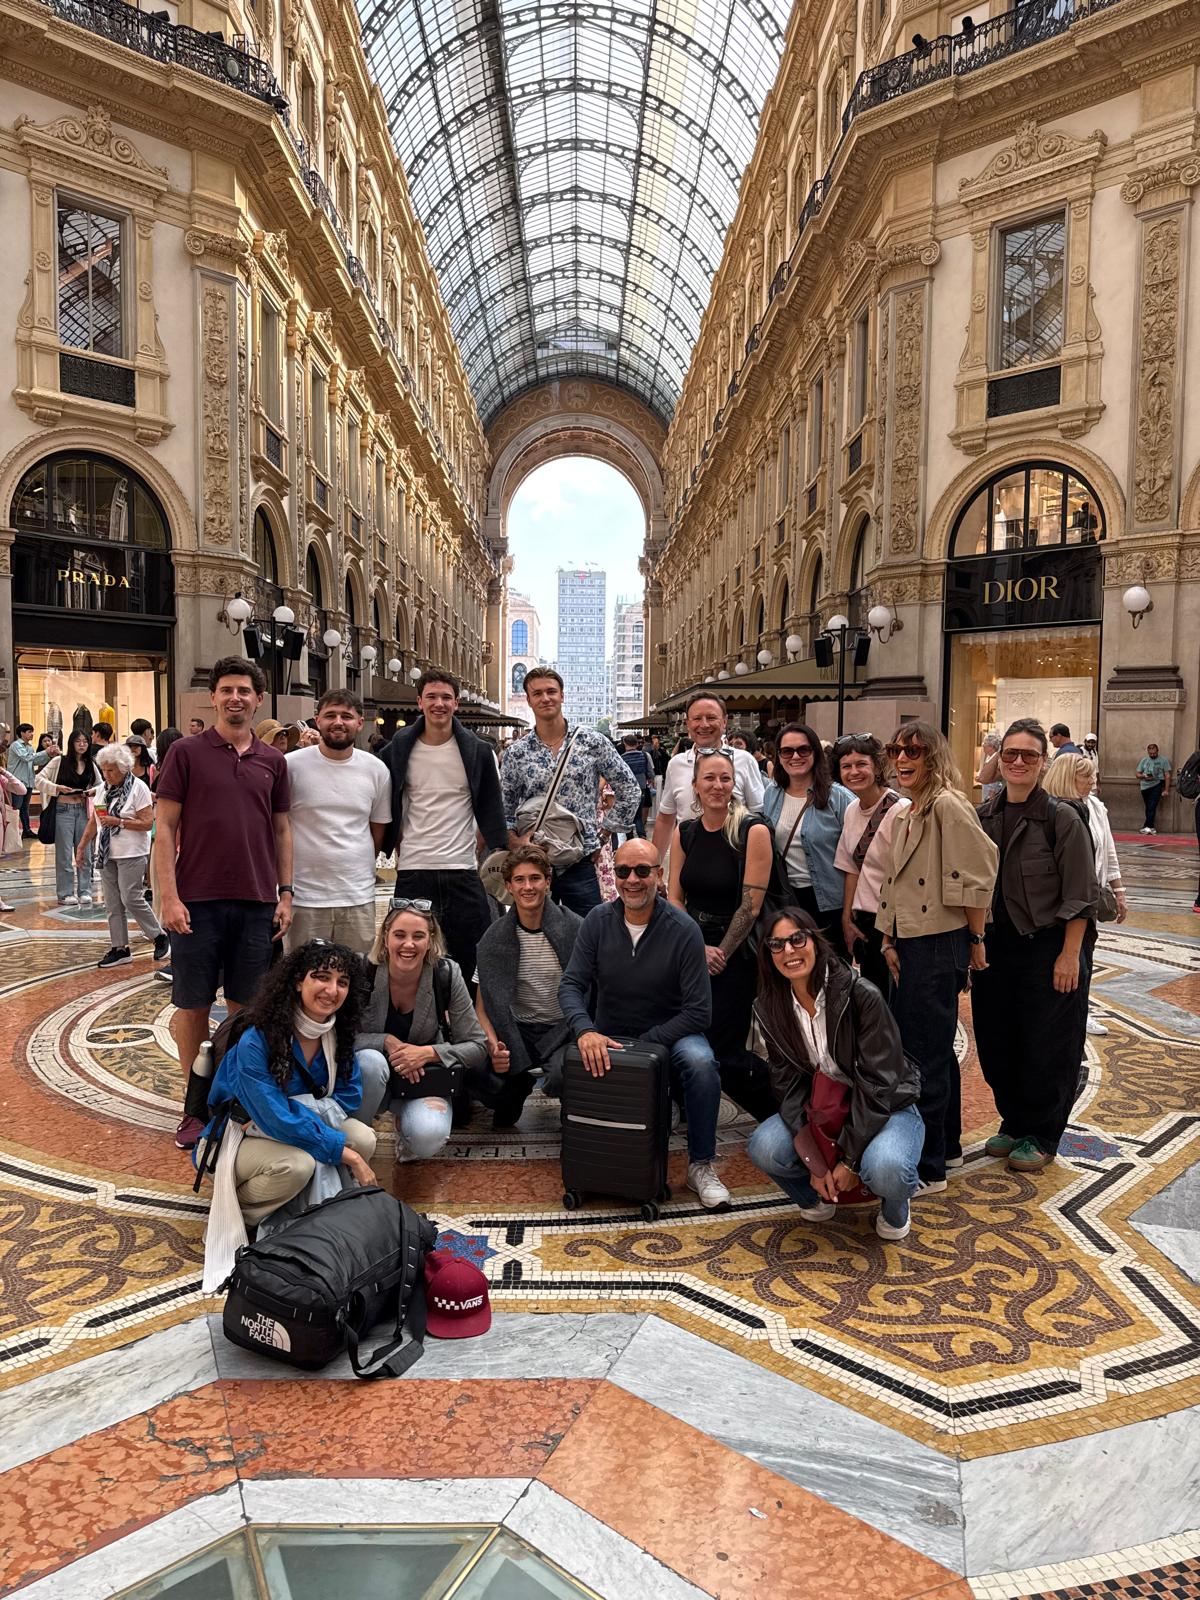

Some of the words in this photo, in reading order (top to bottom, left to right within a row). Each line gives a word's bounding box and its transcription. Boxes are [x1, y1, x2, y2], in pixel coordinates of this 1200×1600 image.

[57, 569, 131, 588] PRADA
[982, 575, 1061, 605] DIOR
[54, 1080, 112, 1106] FERT
[432, 1145, 527, 1158] FER
[460, 1295, 484, 1310] VANS
[240, 1315, 273, 1338] NORTH
[256, 1312, 275, 1328] THE
[249, 1328, 273, 1346] FACE
